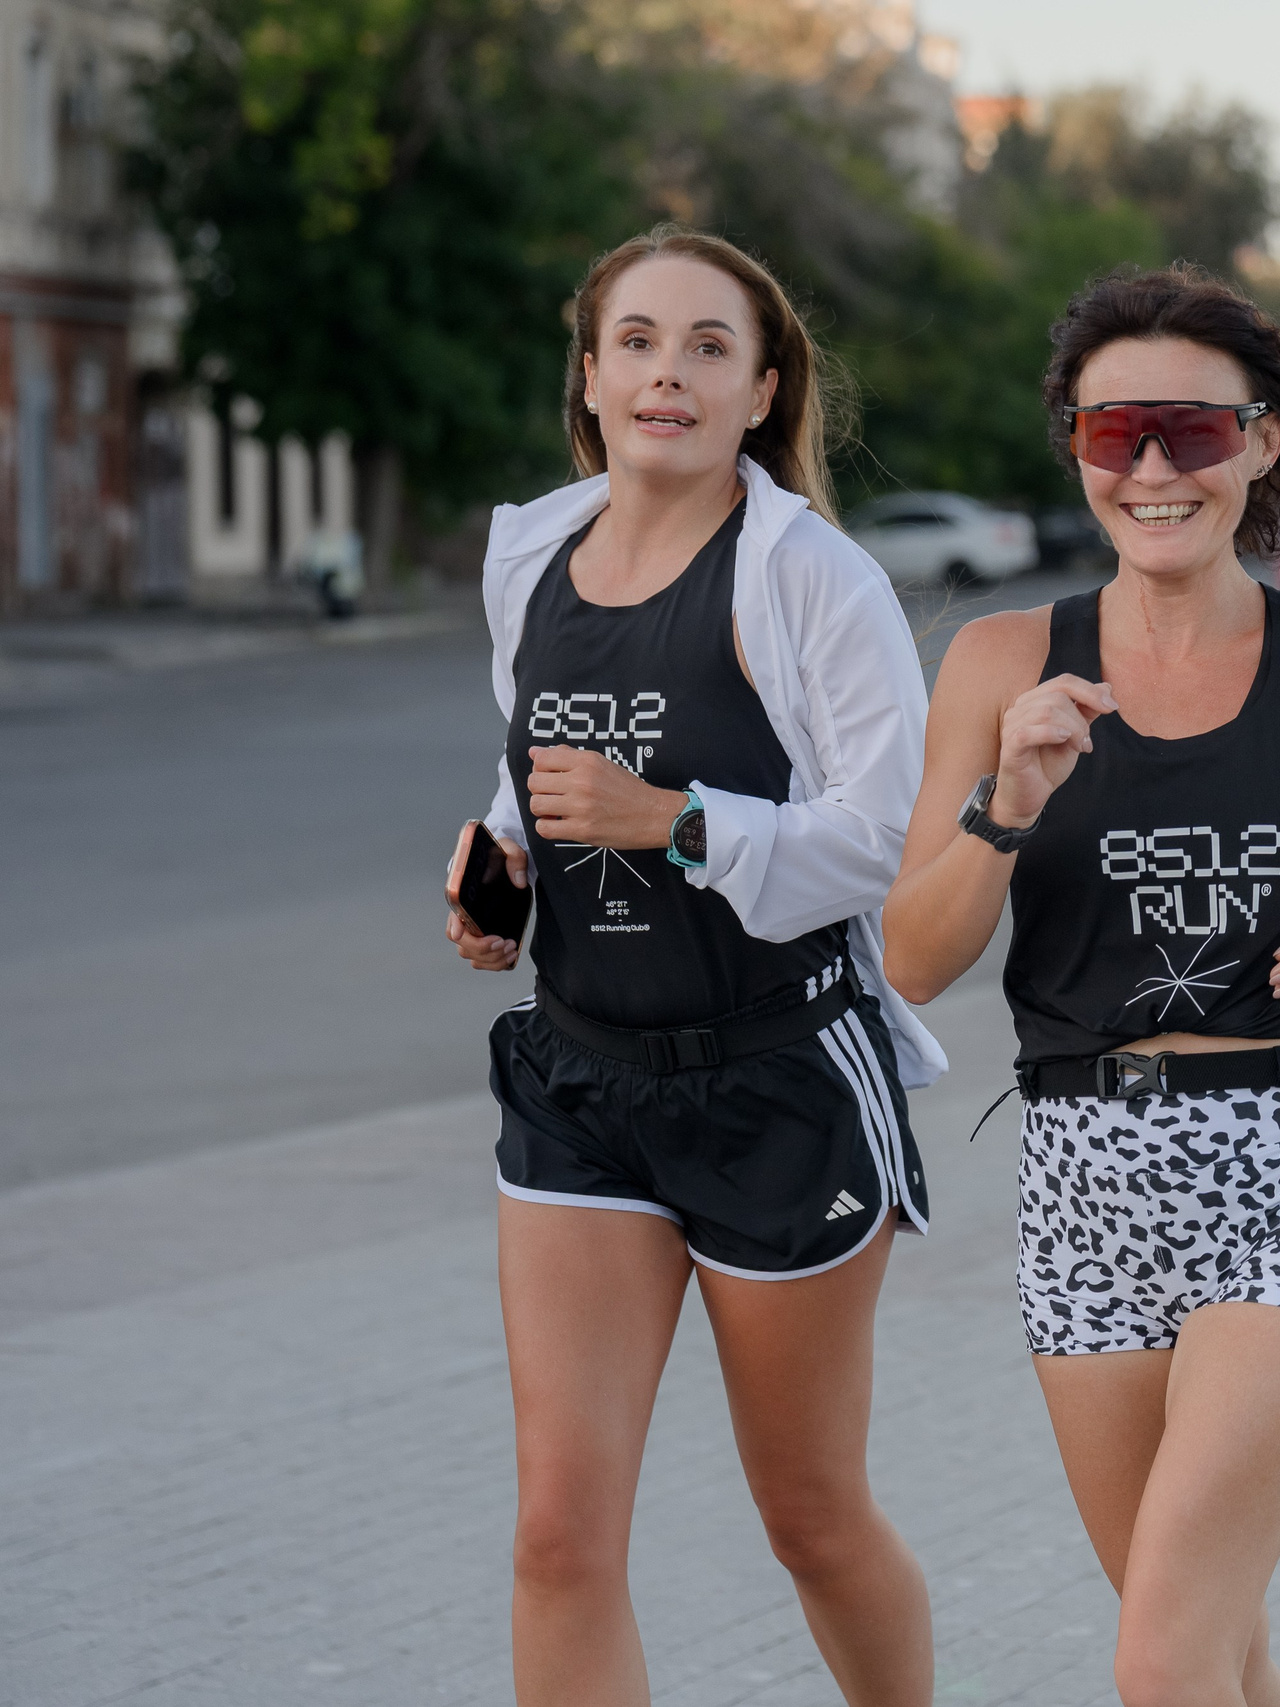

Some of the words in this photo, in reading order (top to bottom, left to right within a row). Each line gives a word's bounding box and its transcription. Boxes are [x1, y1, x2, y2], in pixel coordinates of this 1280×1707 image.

[528, 692, 666, 739] 8512
[591, 924, 605, 932] 8512
[606, 923, 631, 933] Running
